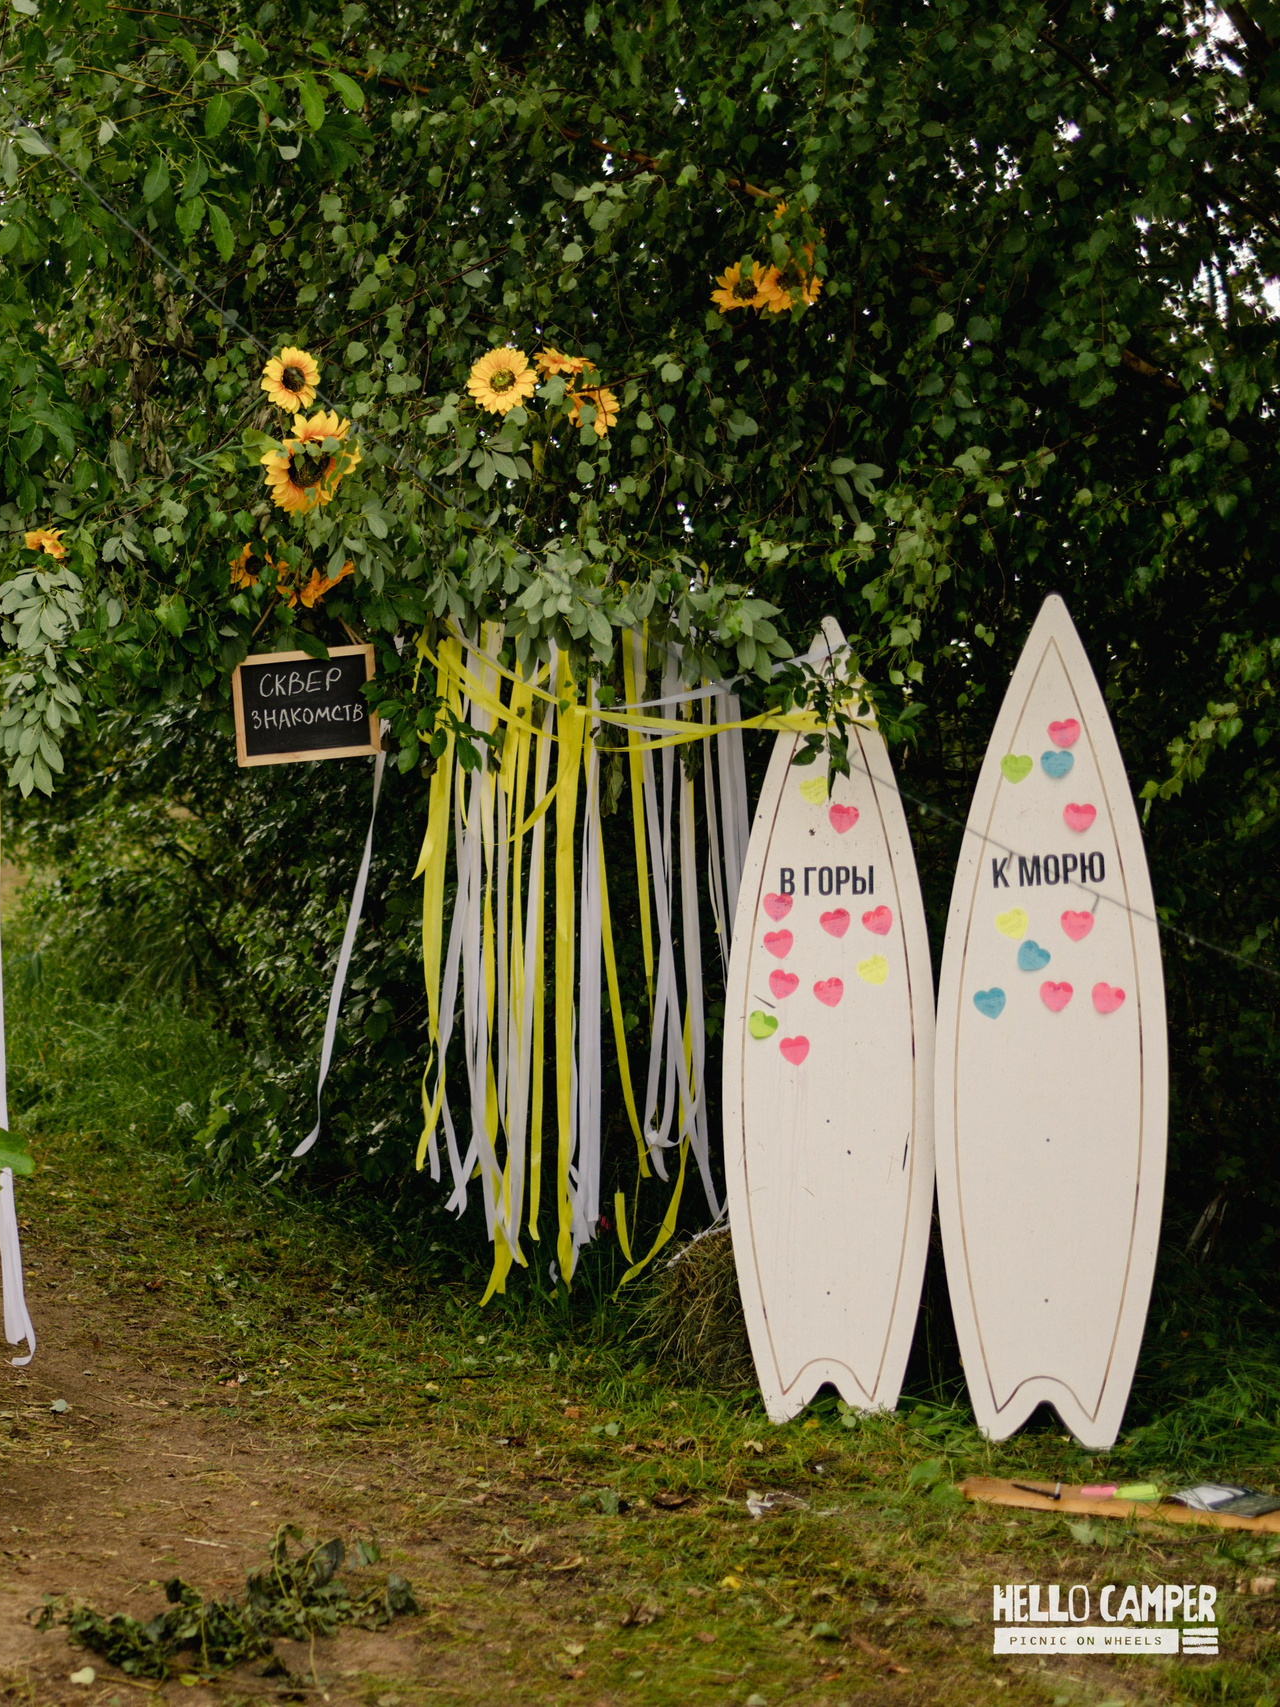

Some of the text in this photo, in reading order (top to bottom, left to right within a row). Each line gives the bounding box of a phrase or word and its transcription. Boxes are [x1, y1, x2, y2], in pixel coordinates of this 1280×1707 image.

[259, 667, 342, 698] СКВЕР
[251, 703, 364, 730] ЗНАКОМСТВ
[780, 865, 875, 896] В ГОРЫ
[991, 851, 1106, 888] К МОРЮ
